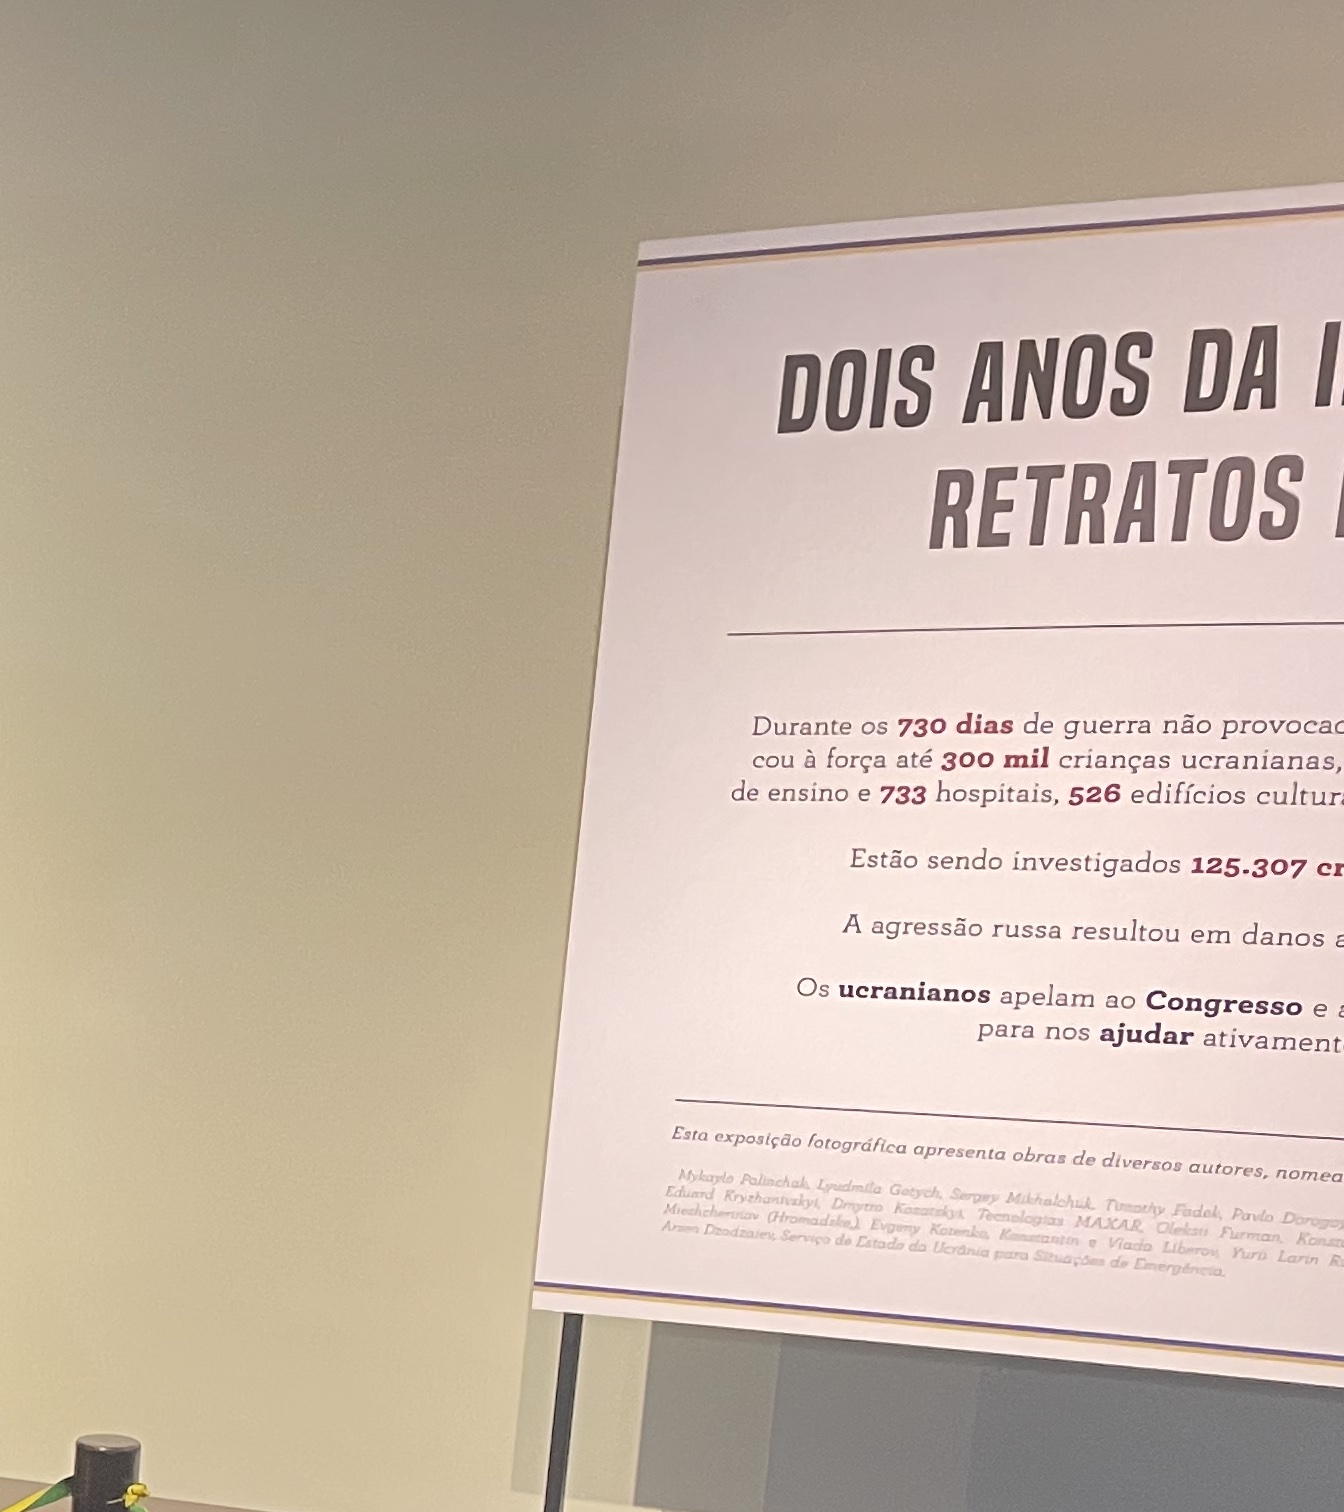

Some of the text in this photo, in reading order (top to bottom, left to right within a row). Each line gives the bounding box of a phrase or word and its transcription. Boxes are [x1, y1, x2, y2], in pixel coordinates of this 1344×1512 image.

[777, 320, 1344, 434] DOIS ANOS DA I
[928, 454, 1305, 551] RETRATOS
[752, 715, 852, 736] Durante
[861, 721, 888, 736] os
[897, 718, 947, 737] 730
[956, 712, 1014, 735] dias
[1023, 712, 1054, 735] de
[1064, 719, 1151, 739] guerra
[1162, 713, 1212, 735] não
[752, 746, 1343, 775] cou à força até 300 mil crianças ucranianas,
[731, 779, 1344, 807] de ensino e 733 hospitais, 526 edifícios cultur
[850, 847, 918, 869] Estão
[927, 847, 1003, 871] sendo
[1012, 850, 1181, 878] investigados
[1190, 856, 1308, 879] 125.307
[842, 913, 862, 934] A
[871, 917, 983, 939] agressão
[992, 923, 1061, 940] russa
[1071, 919, 1180, 943] resultou
[1191, 928, 1231, 944] em
[1242, 921, 1325, 948] danos
[797, 977, 829, 998] Os
[838, 981, 991, 1004] ucranianos
[1000, 984, 1095, 1010] apelam
[1105, 994, 1136, 1010] ao
[1145, 990, 1303, 1018] Congresso
[1313, 1003, 1328, 1018] e
[977, 1022, 1344, 1053] para nos ajudar ativament
[671, 1125, 708, 1142] Esta
[714, 1132, 802, 1150] exposição
[807, 1133, 907, 1154] fotográfica
[913, 1143, 1006, 1160] apresenta
[1012, 1146, 1066, 1164] obras
[1072, 1149, 1096, 1167] de
[1102, 1151, 1183, 1170] diversos
[1188, 1162, 1269, 1180] autores,
